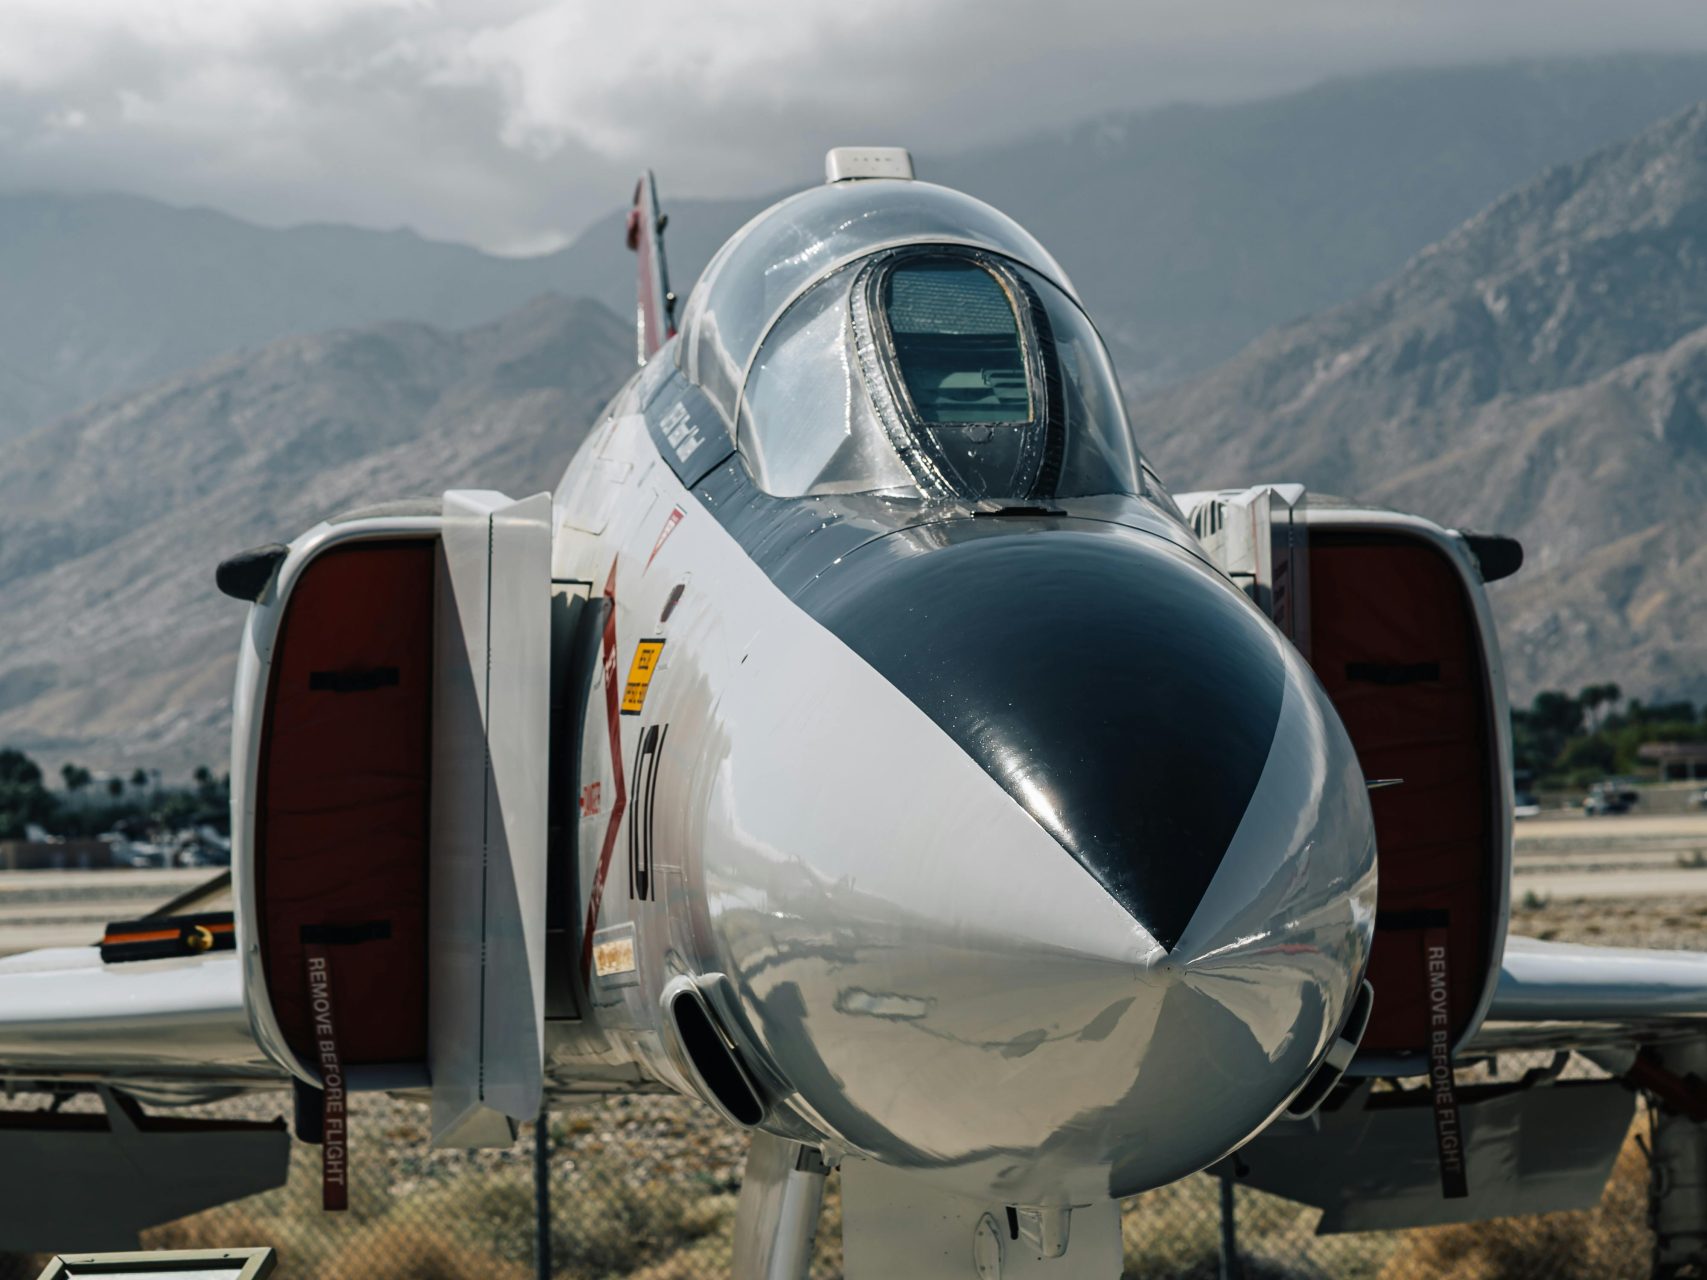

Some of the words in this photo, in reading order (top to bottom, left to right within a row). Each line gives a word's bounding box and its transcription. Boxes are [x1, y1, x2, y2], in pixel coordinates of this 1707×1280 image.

[308, 957, 332, 1035] REMOVE
[1428, 946, 1448, 1026] REMOVE
[319, 1040, 343, 1114] BEFORE
[1431, 1030, 1453, 1105] BEFORE
[326, 1118, 345, 1186] FLIGHT
[1437, 1108, 1461, 1174] FLIGHT
